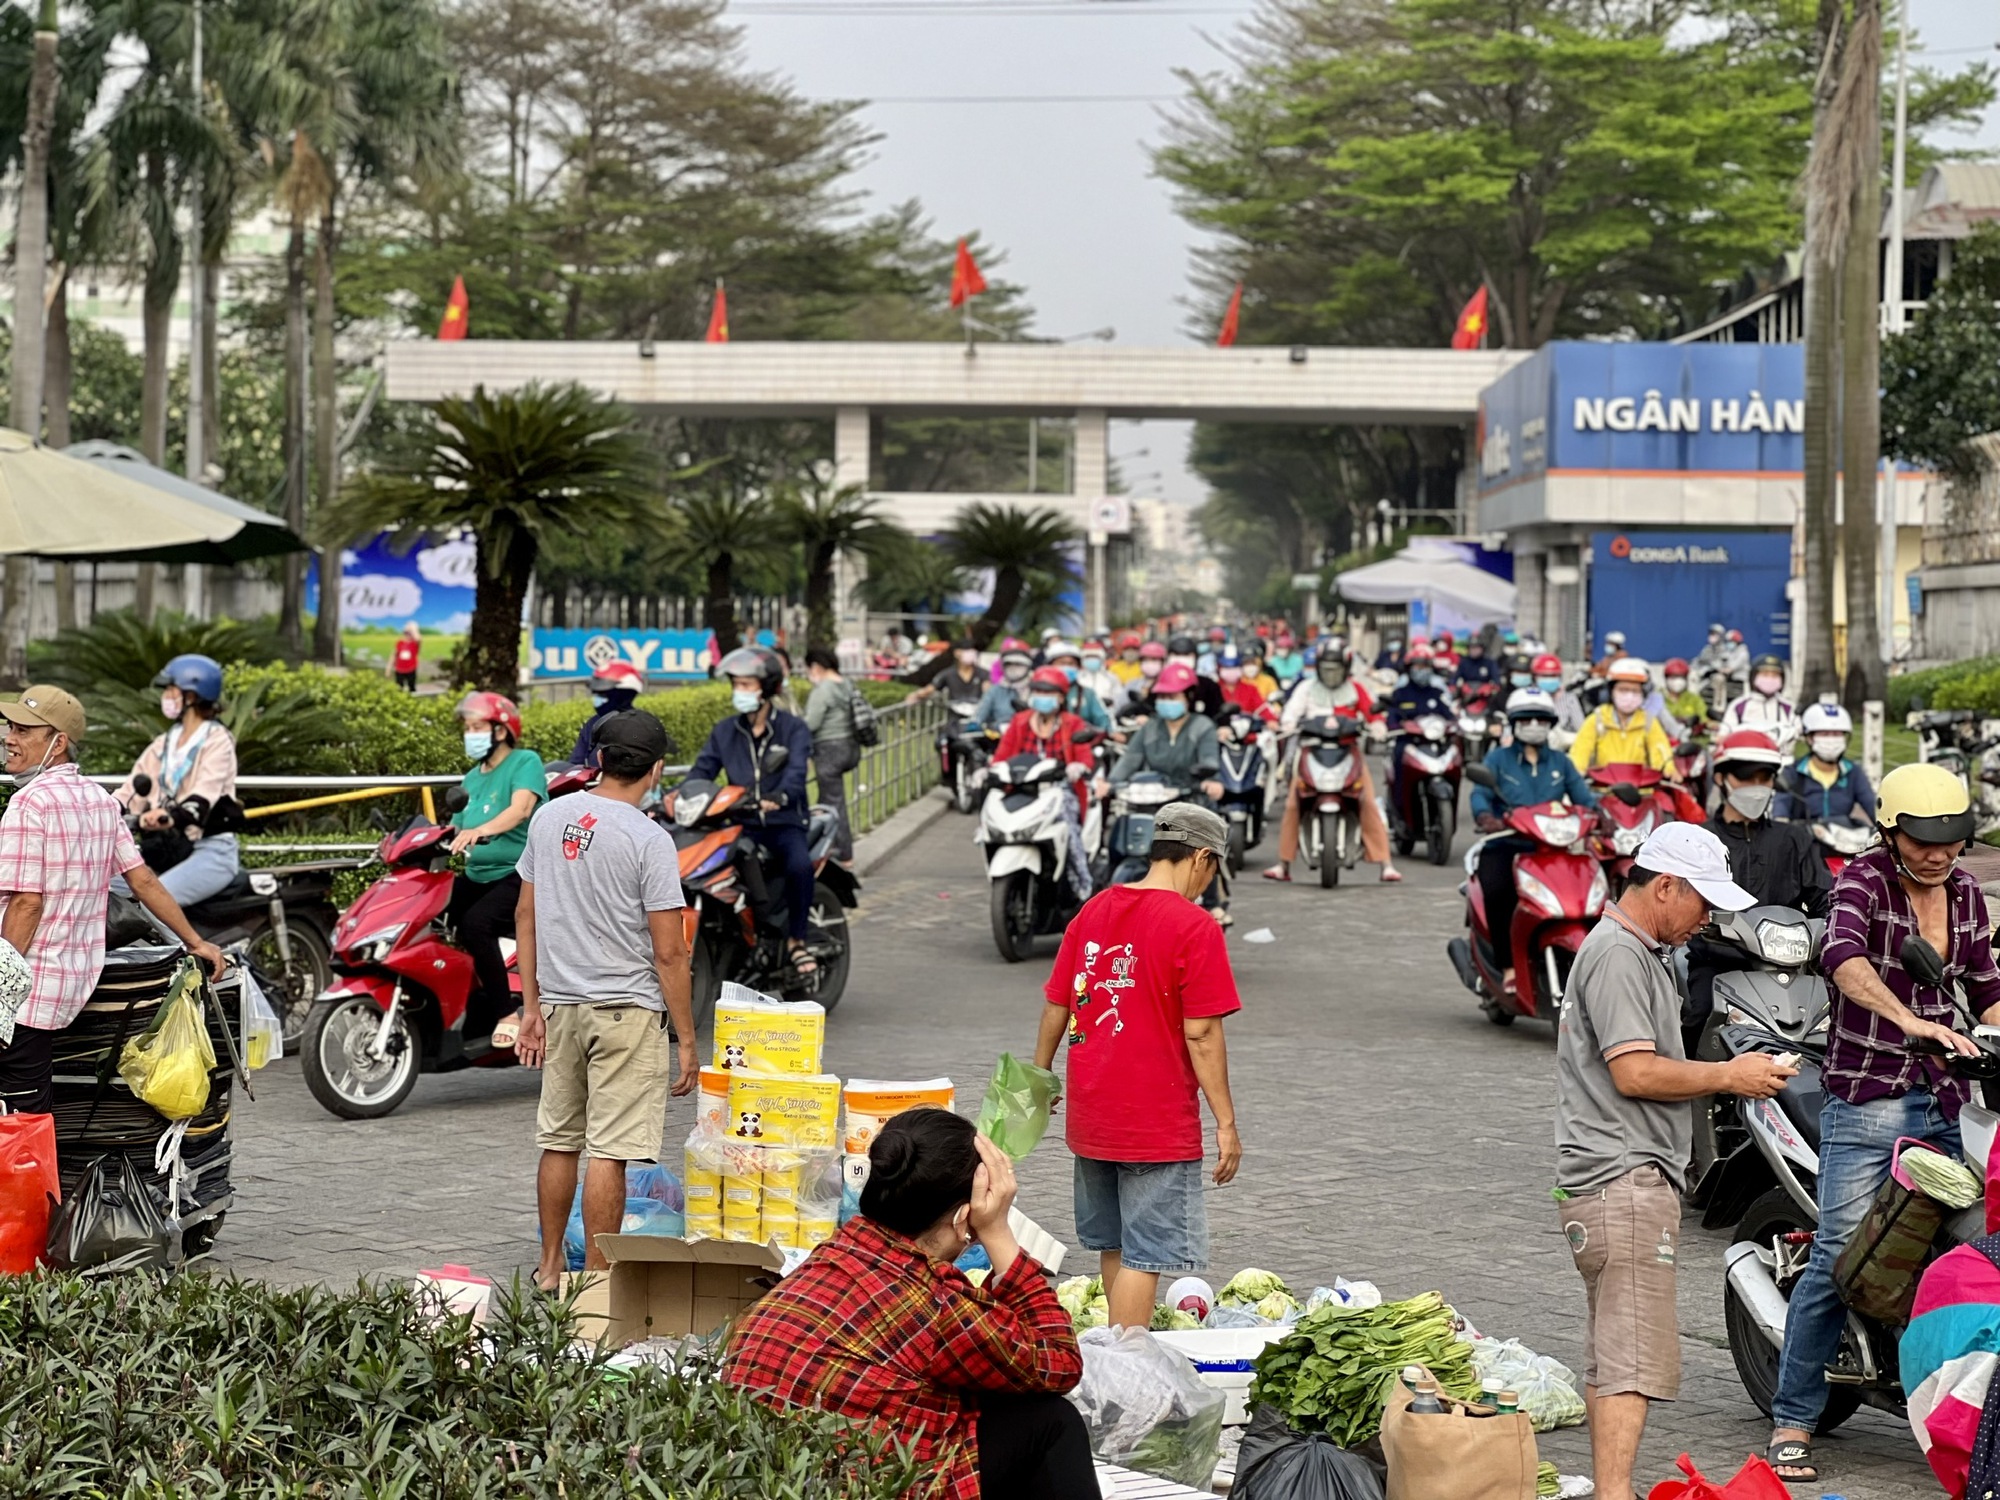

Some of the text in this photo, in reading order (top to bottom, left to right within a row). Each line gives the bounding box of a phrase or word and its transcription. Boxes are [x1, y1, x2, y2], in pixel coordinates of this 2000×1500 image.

[1574, 389, 1700, 432] NGÂN
[1711, 390, 1805, 432] HÀN
[1689, 545, 1729, 563] Bank
[789, 1059, 795, 1068] 6
